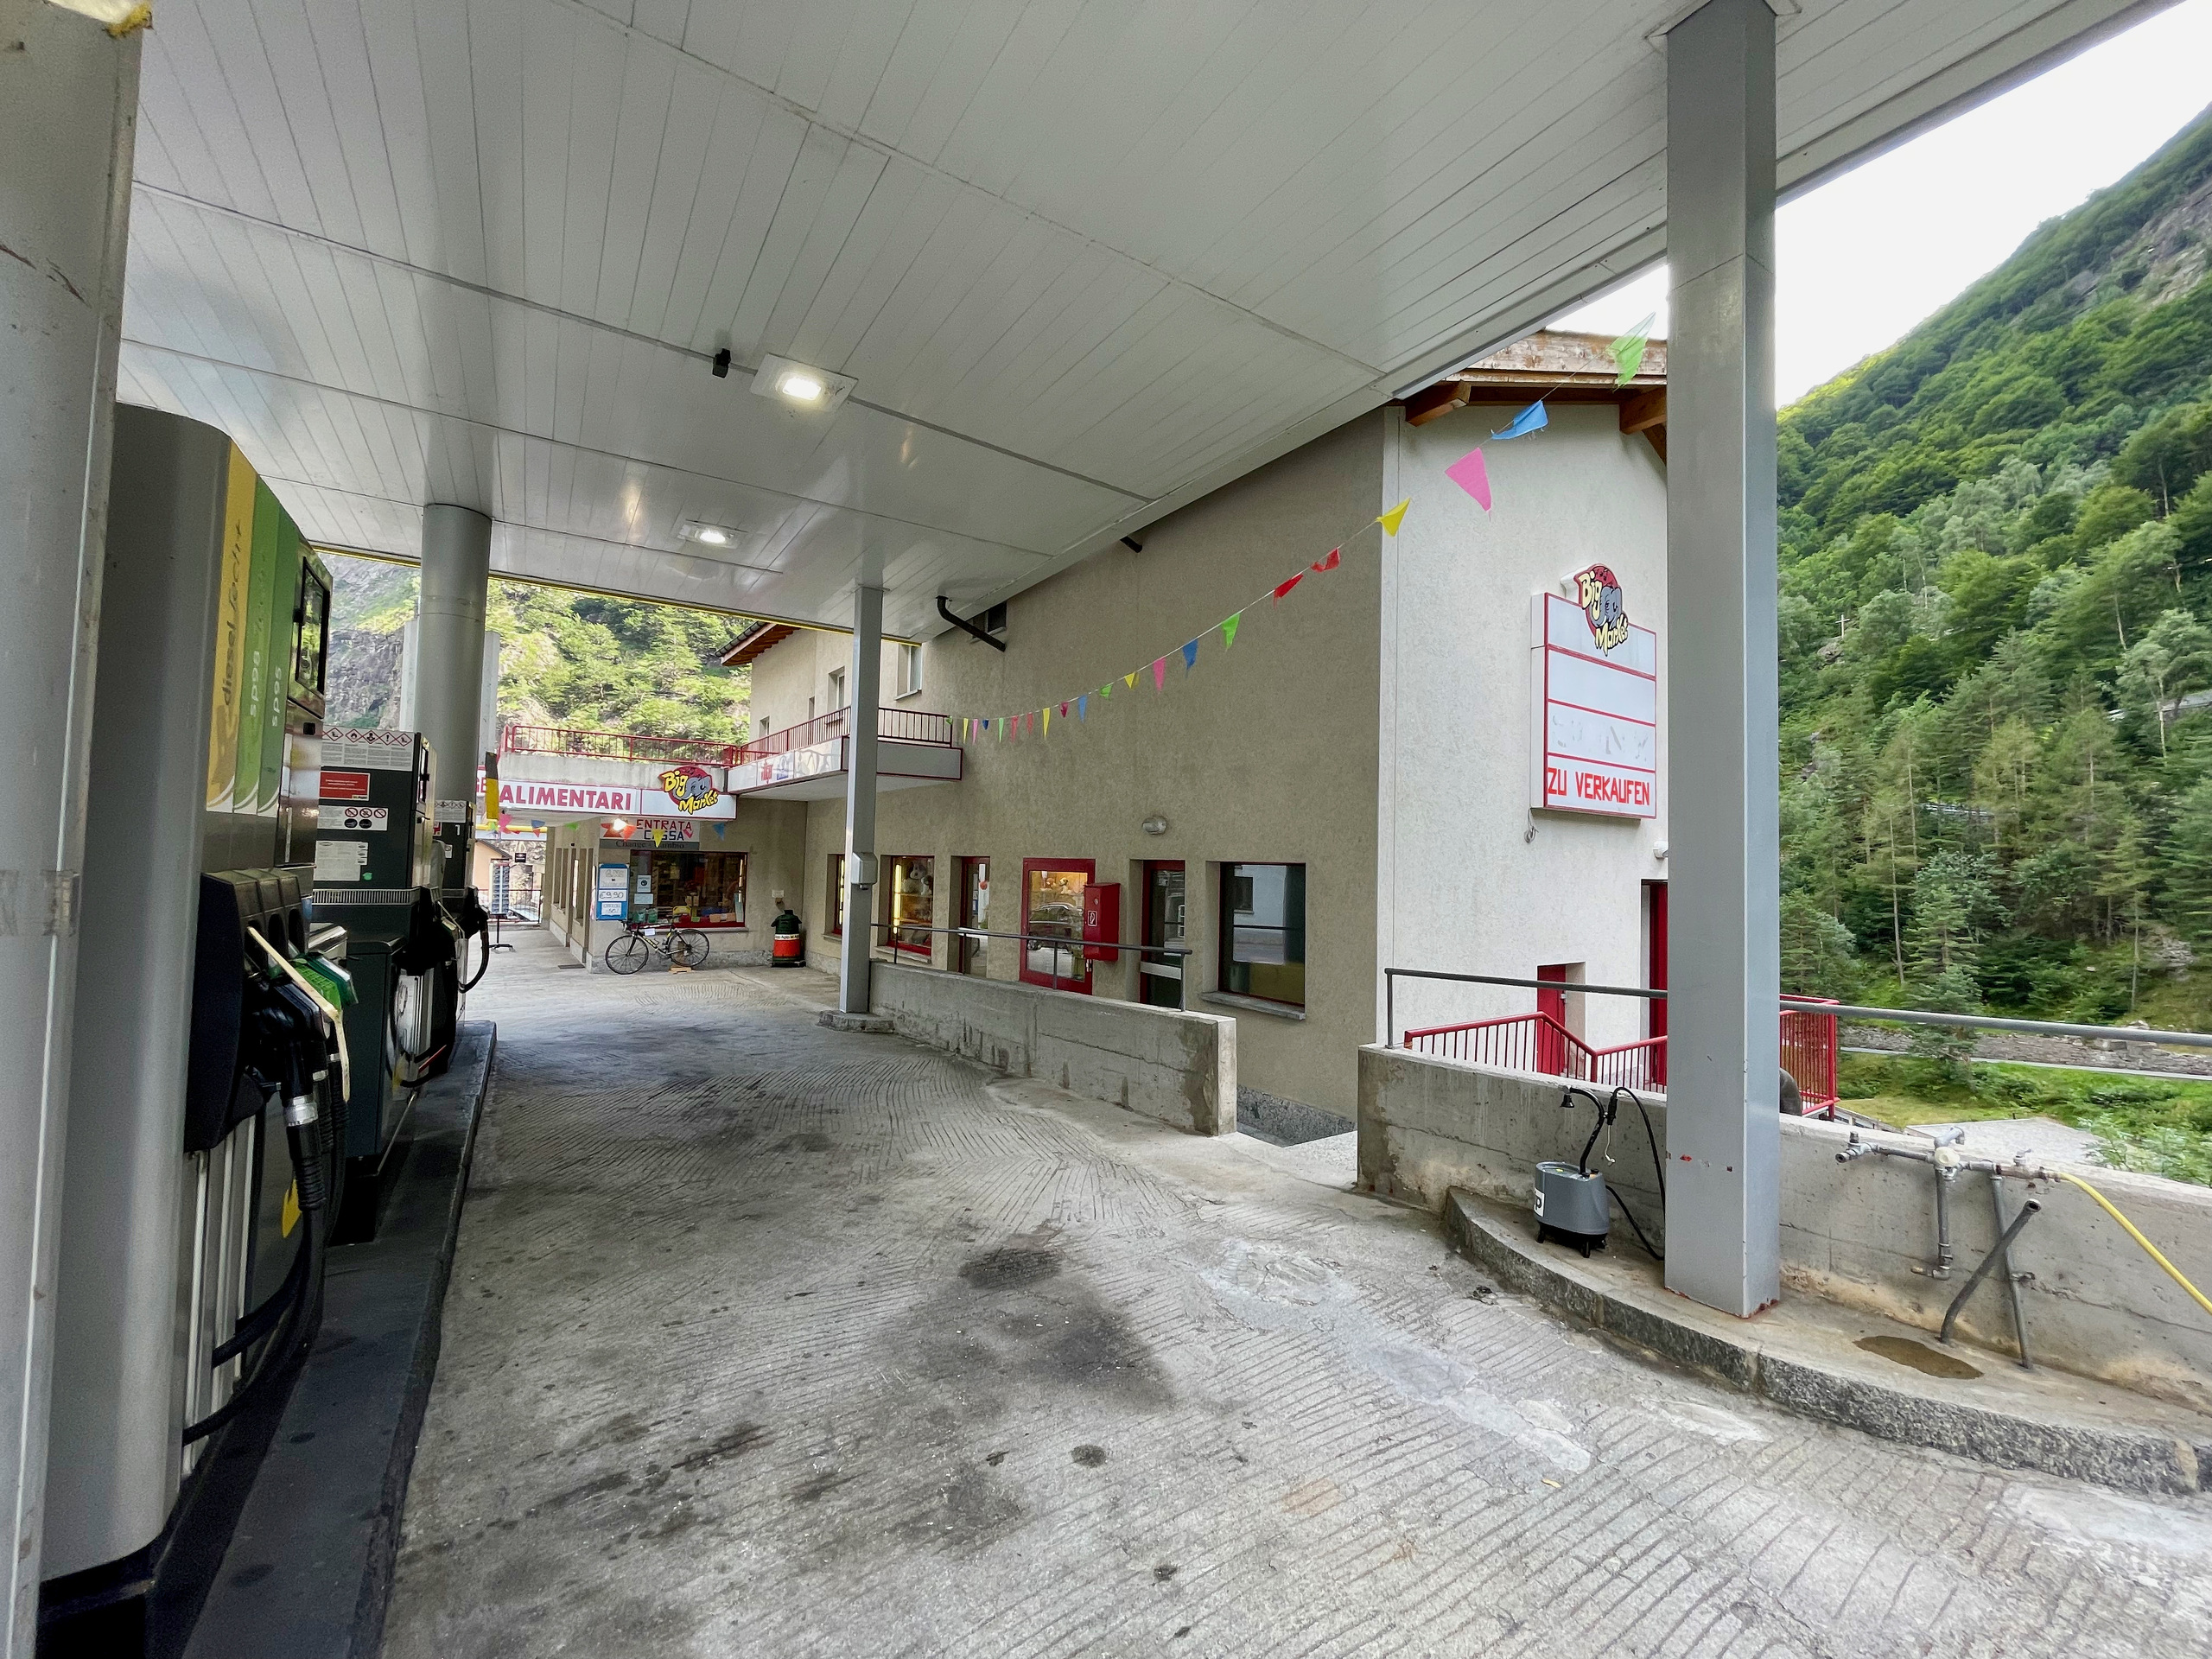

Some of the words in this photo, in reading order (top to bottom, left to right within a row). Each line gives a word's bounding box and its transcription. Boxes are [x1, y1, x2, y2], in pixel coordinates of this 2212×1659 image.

[1578, 569, 1603, 621] Big
[1594, 613, 1629, 657] Market
[499, 784, 632, 811] ALIMENTARI
[661, 769, 689, 798] Big
[1548, 767, 1567, 797] ZU
[1575, 771, 1650, 806] VERKAUFEN
[677, 789, 719, 815] Market
[636, 818, 692, 831] ENTRATA
[644, 829, 684, 841] CSSA
